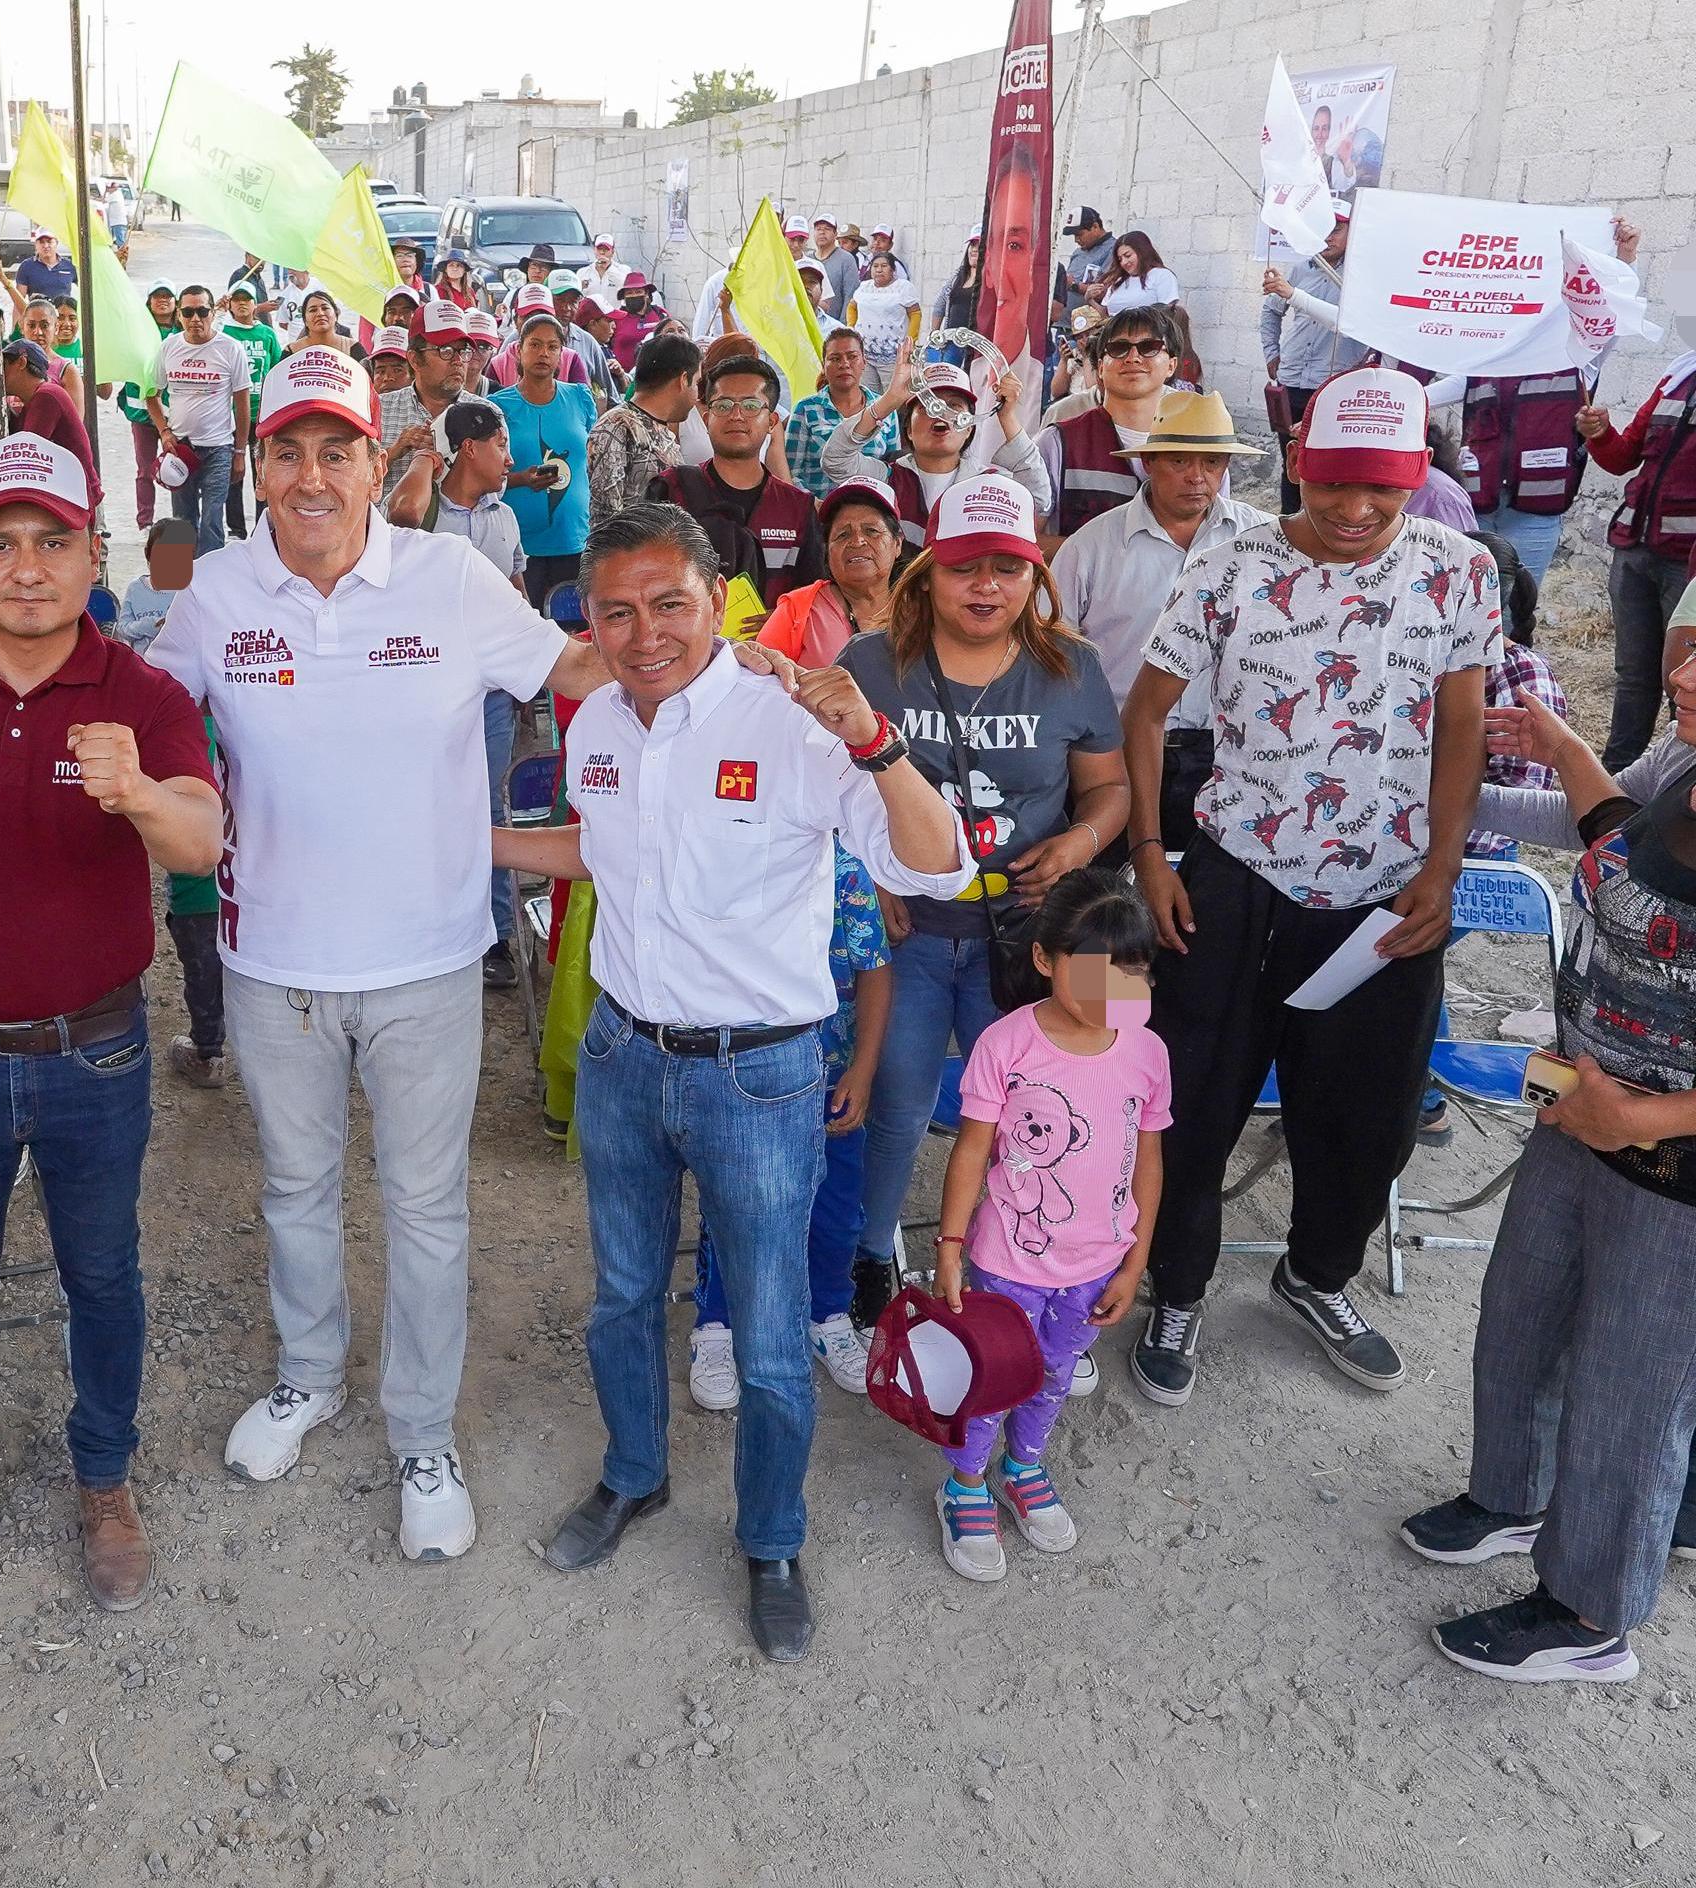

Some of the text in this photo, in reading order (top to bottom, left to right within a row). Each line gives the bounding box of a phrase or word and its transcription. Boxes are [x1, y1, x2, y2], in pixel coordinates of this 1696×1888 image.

[226, 184, 263, 210] VERDE
[1458, 233, 1519, 252] PEPE
[1422, 250, 1544, 271] CHEDRAUI
[1434, 270, 1480, 279] PRESIDENTE
[1423, 288, 1525, 301] POR LA PUEBLA
[1429, 300, 1513, 314] DEL FUTURO
[1419, 324, 1453, 336] VOTA
[1459, 330, 1498, 339] morena
[306, 351, 338, 363] PEPE
[290, 359, 353, 377] CHEDRAUI
[168, 371, 221, 381] ARMENTA
[294, 380, 337, 391] morena
[1357, 389, 1391, 400] PEPE
[1339, 400, 1405, 411] CHEDRAUI
[1341, 425, 1387, 435] morena
[3, 442, 37, 452] PEPE
[981, 485, 1010, 498] PEPE
[964, 494, 1021, 512] CHEDRAUI
[967, 515, 1007, 525] morena
[761, 528, 797, 538] morena
[1234, 540, 1294, 564] BWHAAM!
[1356, 549, 1403, 590] BRACK!
[232, 628, 275, 643] POR LA
[386, 636, 422, 649] PEPE
[226, 637, 288, 657] PUEBLA
[368, 646, 440, 661] CHEDRAUI
[225, 652, 288, 668] DEL FUTURO
[1151, 636, 1194, 677] BWHAAM!
[1387, 651, 1432, 678] BWHAA
[225, 672, 292, 685] morena PT
[1239, 658, 1298, 687] BWHAAM!
[1347, 679, 1390, 715] BRACK!
[586, 752, 614, 766] JOSÉ LUIS
[720, 775, 753, 798] PT
[1336, 799, 1381, 835] BRACK!
